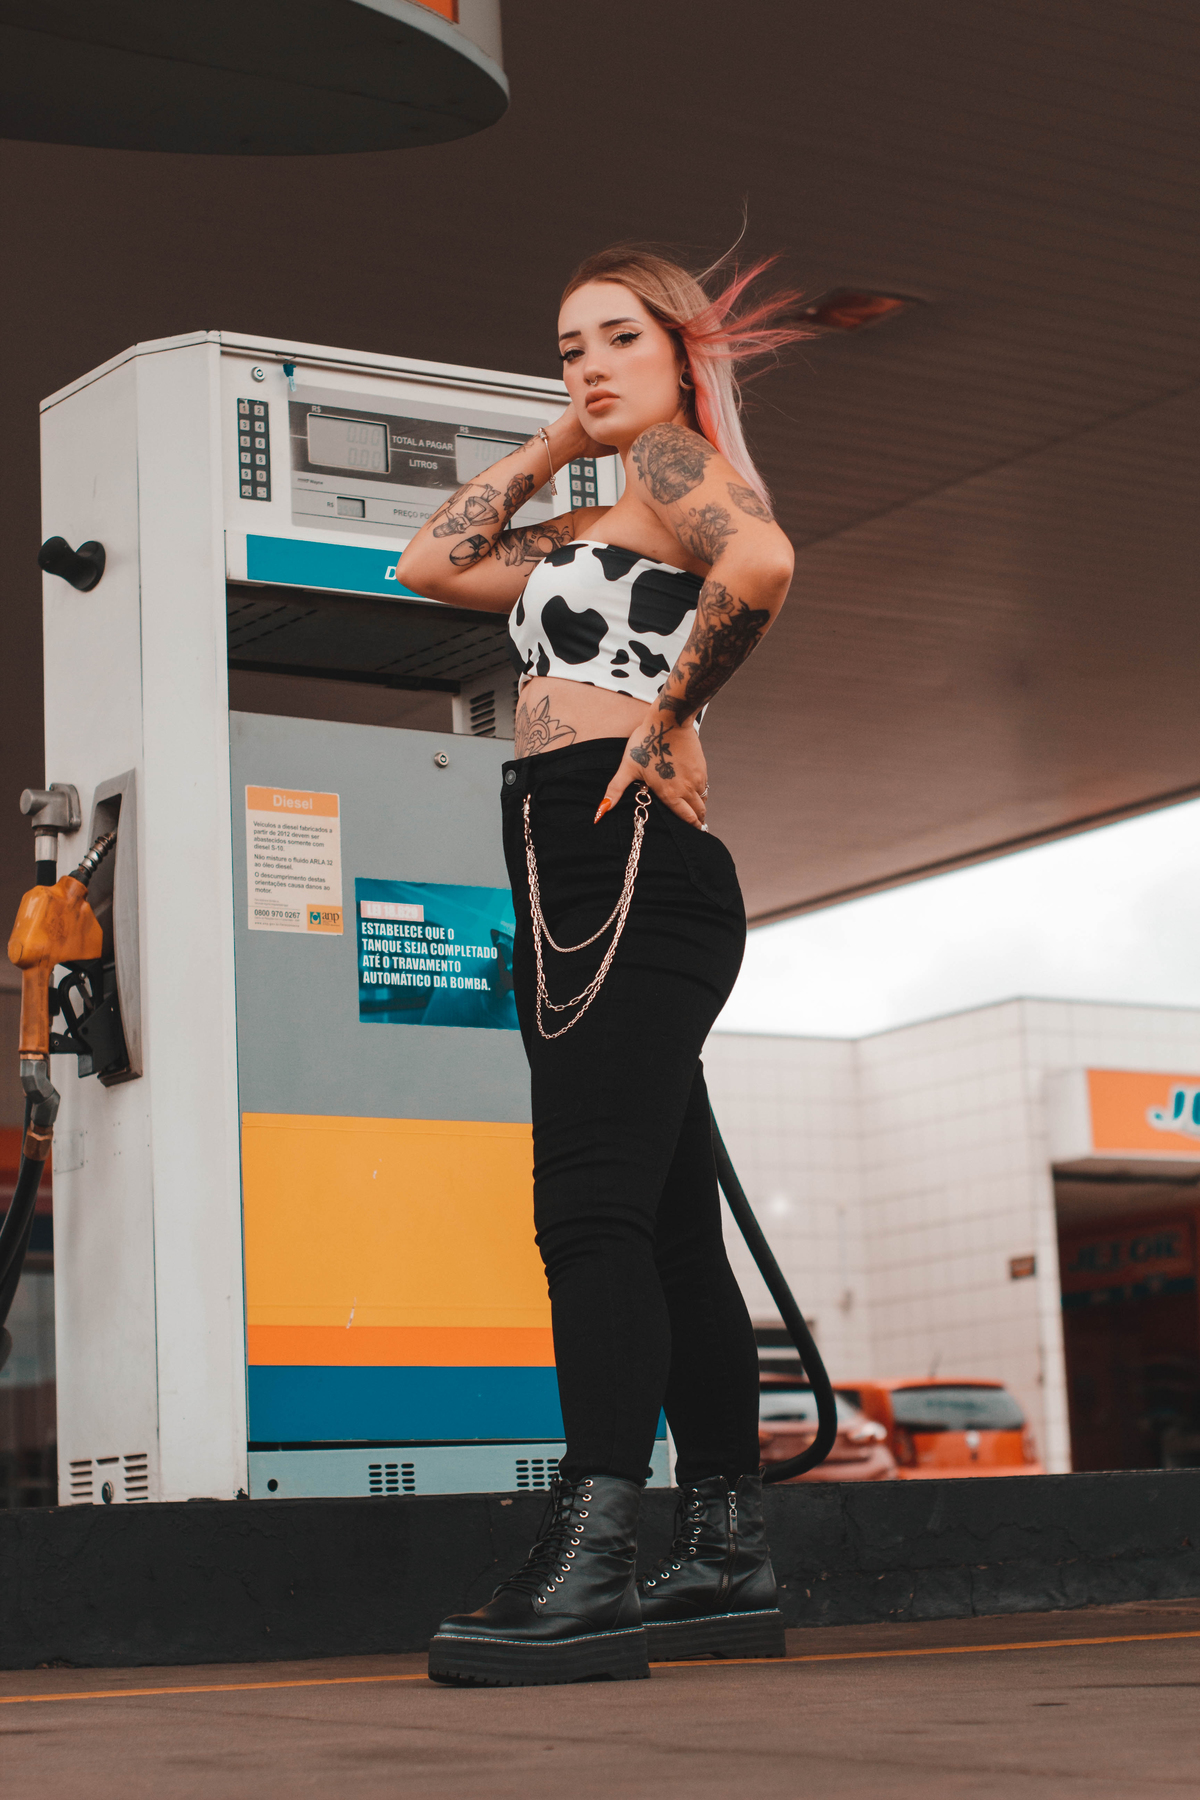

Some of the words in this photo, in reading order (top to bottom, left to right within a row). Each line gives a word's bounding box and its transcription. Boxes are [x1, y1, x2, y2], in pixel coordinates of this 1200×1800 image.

[312, 405, 322, 413] R$
[460, 426, 469, 434] R$
[392, 435, 417, 446] TOTAL
[418, 439, 425, 447] A
[426, 440, 454, 451] PAGAR
[409, 459, 438, 470] LITROS
[393, 508, 418, 519] PREÇO
[273, 795, 313, 810] Diesel
[300, 825, 328, 833] fabricados
[253, 836, 287, 844] abastecidos
[262, 861, 274, 869] óleo
[260, 872, 307, 882] descumprimento
[254, 880, 287, 888] orientações
[254, 909, 270, 917] 0800
[271, 910, 283, 918] 970
[284, 911, 300, 919] 0267
[367, 903, 381, 916] LEI
[322, 911, 340, 923] anp
[361, 922, 423, 938] ESTABELECE
[425, 927, 445, 940] QUE
[448, 928, 455, 940] O
[362, 939, 402, 953] TANQUE
[404, 941, 428, 955] SEJA
[430, 943, 498, 959] COMPLETADO
[363, 954, 380, 968] ATÉ
[383, 956, 390, 969] O
[392, 957, 461, 973] TRAVAMENTO
[363, 971, 431, 987] AUTOMÁTICO
[434, 976, 448, 989] DA
[450, 977, 491, 991] BOMBA.
